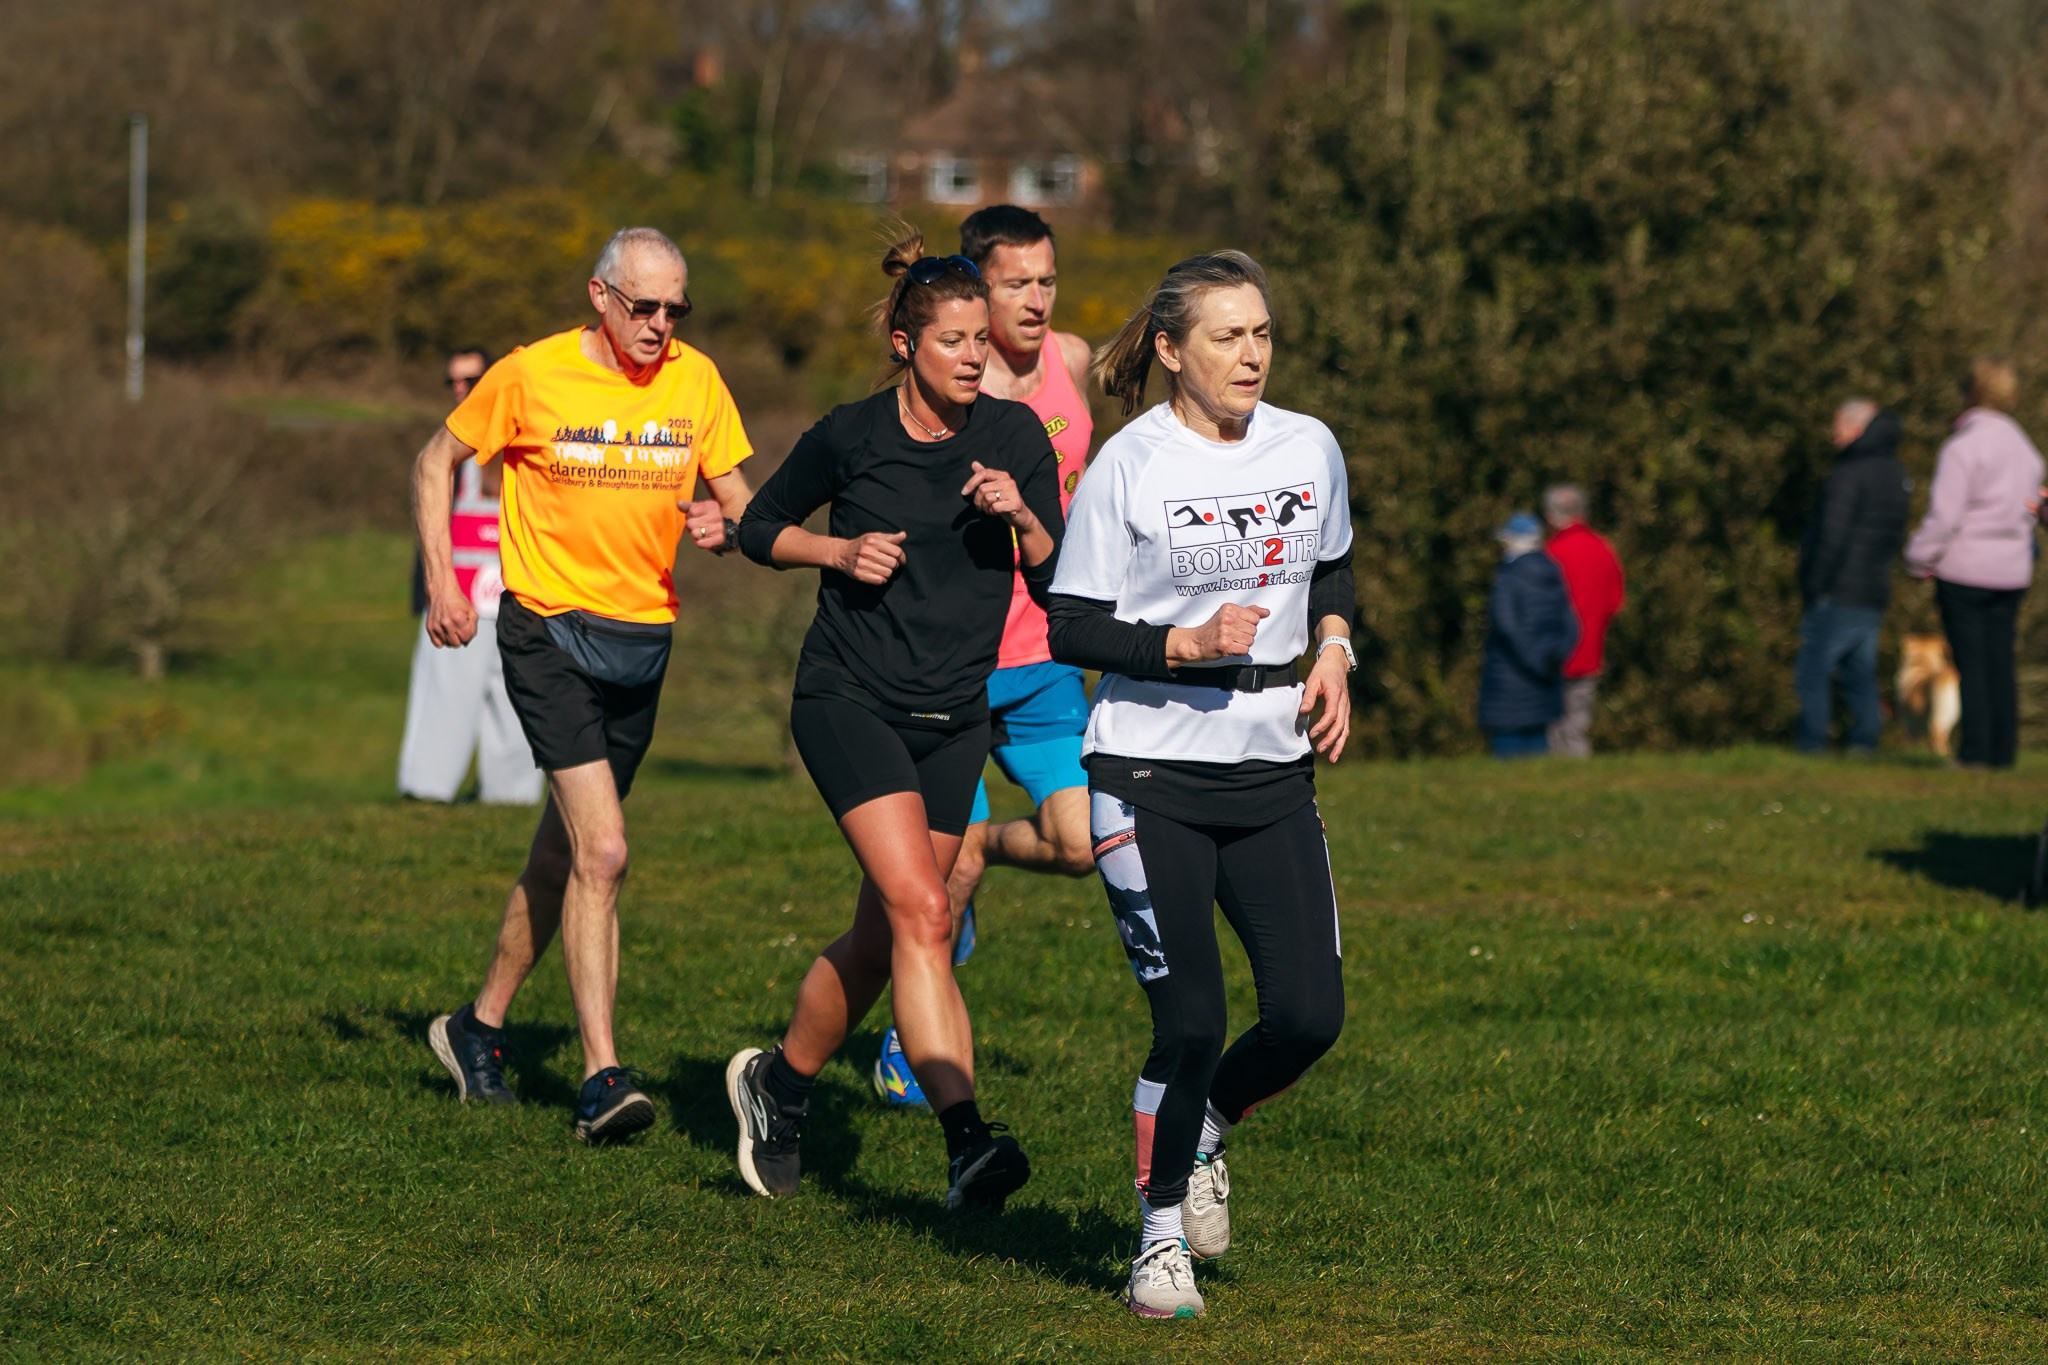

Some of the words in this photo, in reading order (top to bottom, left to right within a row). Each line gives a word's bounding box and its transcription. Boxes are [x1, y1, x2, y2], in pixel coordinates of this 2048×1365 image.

[667, 418, 693, 429] 2025
[551, 475, 586, 489] Salisbury
[588, 479, 595, 488] &
[597, 480, 640, 491] Broughton
[641, 482, 650, 490] to
